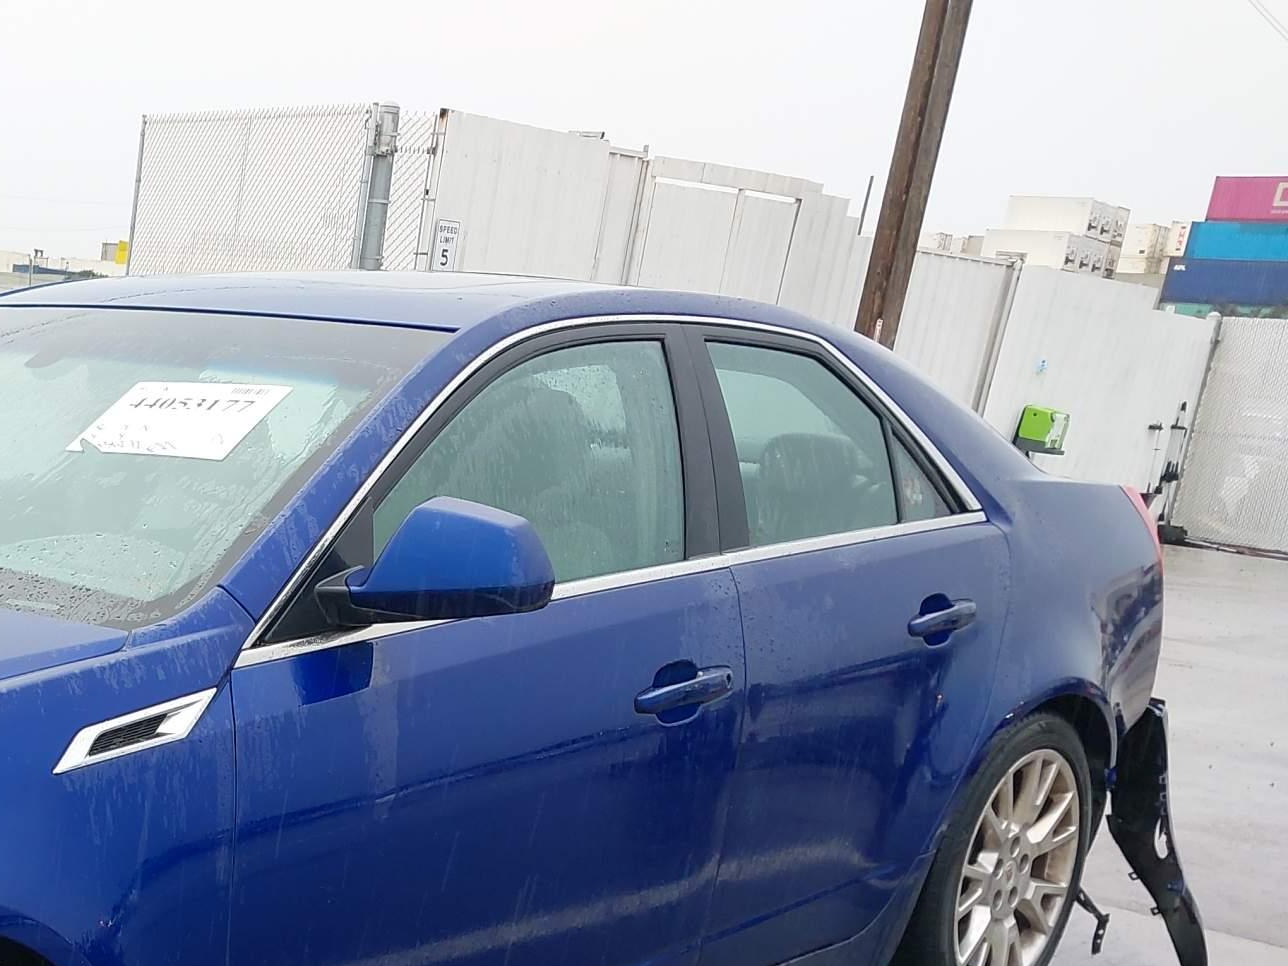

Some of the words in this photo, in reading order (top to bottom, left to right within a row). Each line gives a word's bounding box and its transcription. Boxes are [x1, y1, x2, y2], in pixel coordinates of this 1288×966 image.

[439, 225, 458, 235] SPEED
[439, 236, 455, 244] LIMIT
[439, 248, 449, 266] 5
